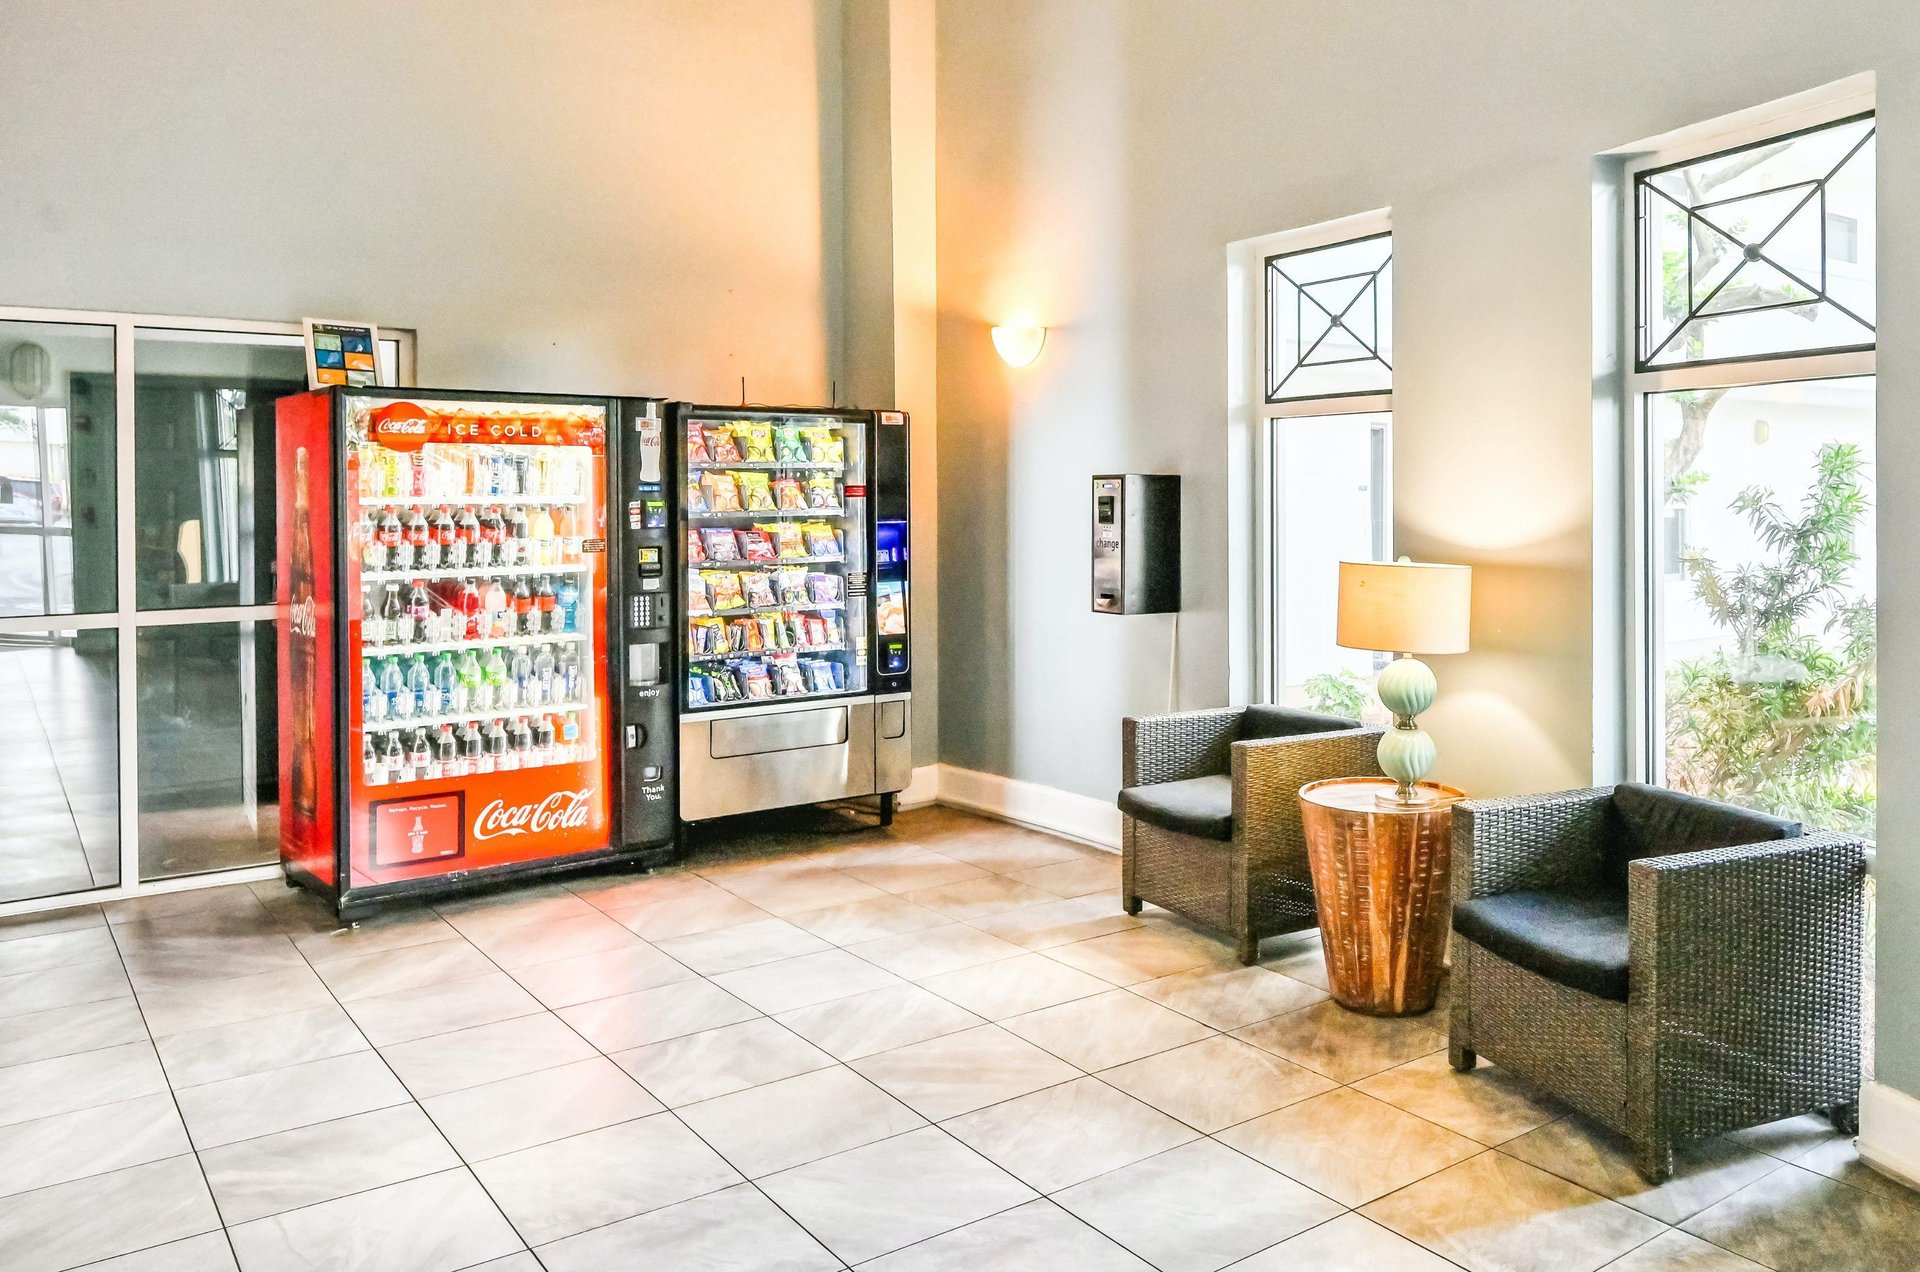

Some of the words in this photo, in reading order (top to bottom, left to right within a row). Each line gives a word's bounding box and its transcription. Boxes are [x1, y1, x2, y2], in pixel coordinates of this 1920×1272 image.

[447, 423, 479, 436] ICE
[490, 425, 543, 438] COLD
[1096, 538, 1120, 551] change
[639, 689, 660, 697] enjoy
[642, 784, 665, 794] Thank
[473, 788, 596, 841] Coca-Cola
